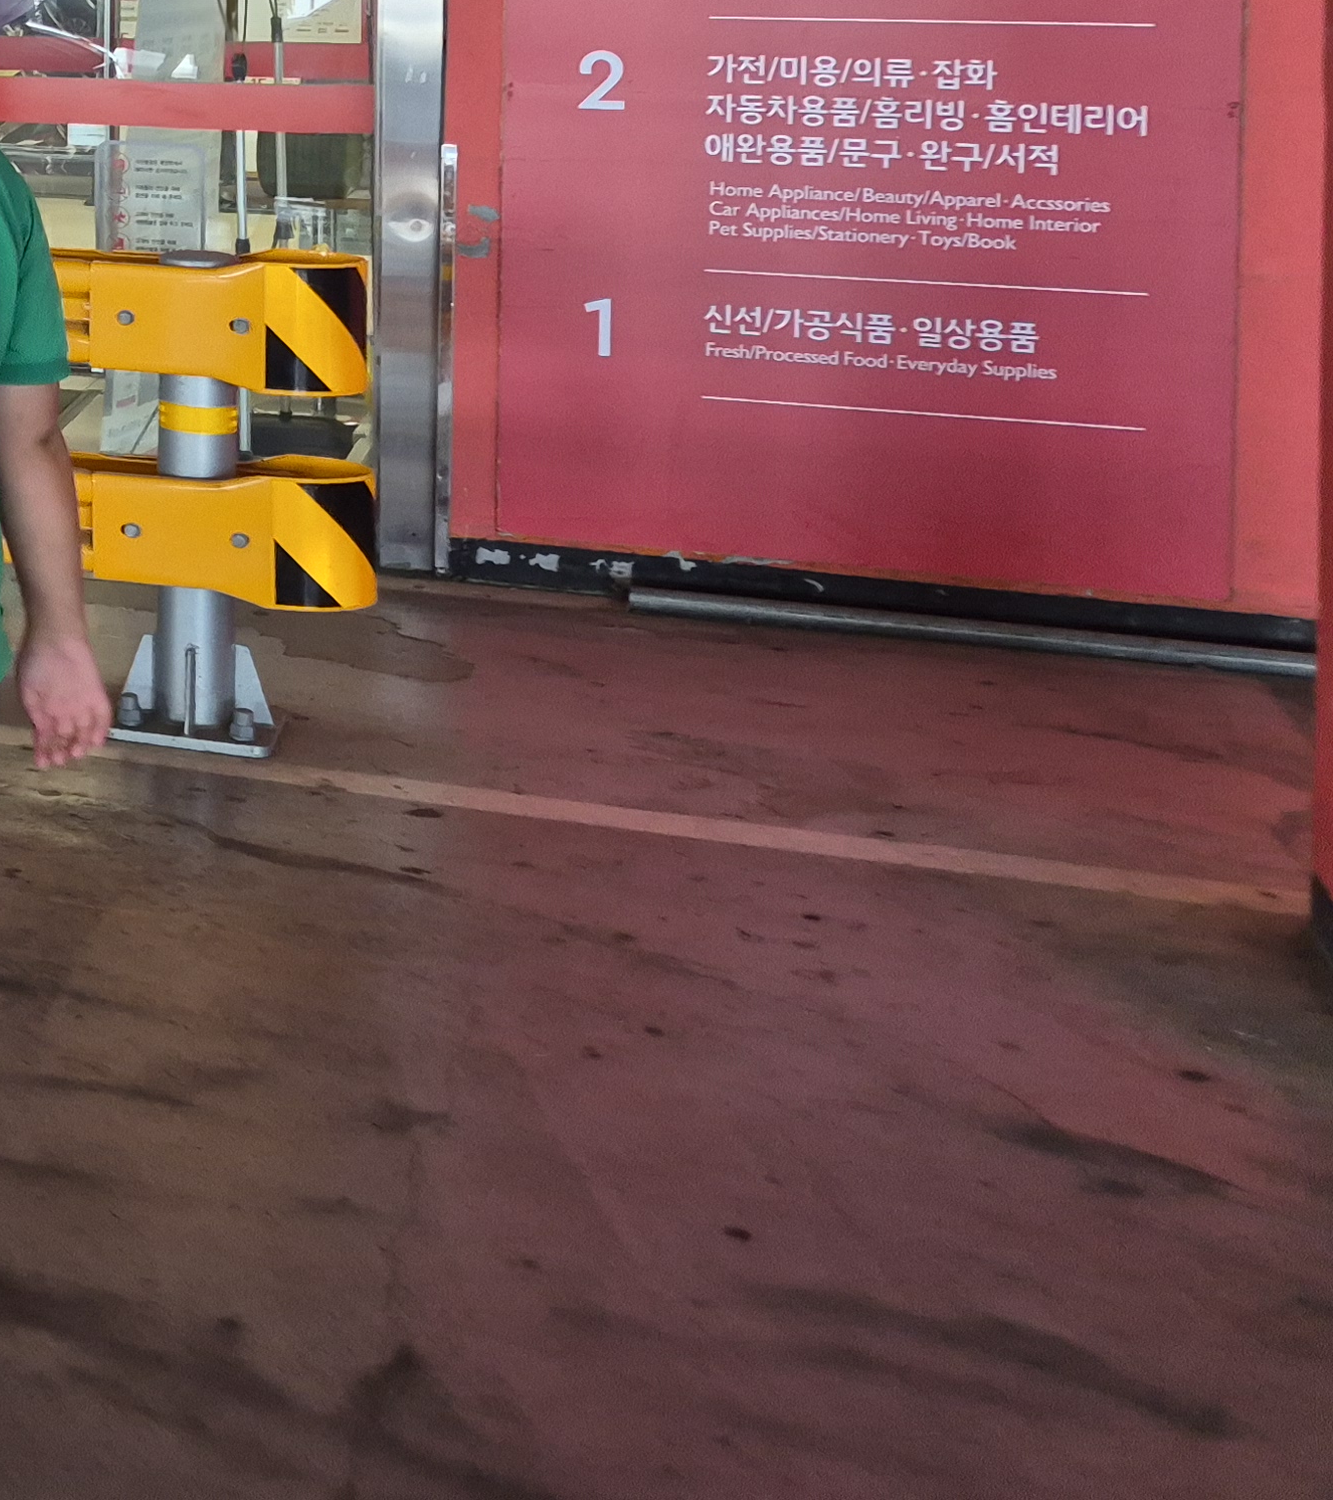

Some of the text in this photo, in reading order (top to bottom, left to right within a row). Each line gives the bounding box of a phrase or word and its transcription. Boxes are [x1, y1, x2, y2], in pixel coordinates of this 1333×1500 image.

[578, 50, 625, 111] 2
[709, 180, 763, 198] Home
[709, 201, 740, 217] Car
[1029, 215, 1101, 233] Interior
[709, 221, 737, 237] Pet
[584, 298, 612, 357] 1
[705, 342, 839, 366] Fresh/Processed
[983, 360, 1058, 381] Supplies
